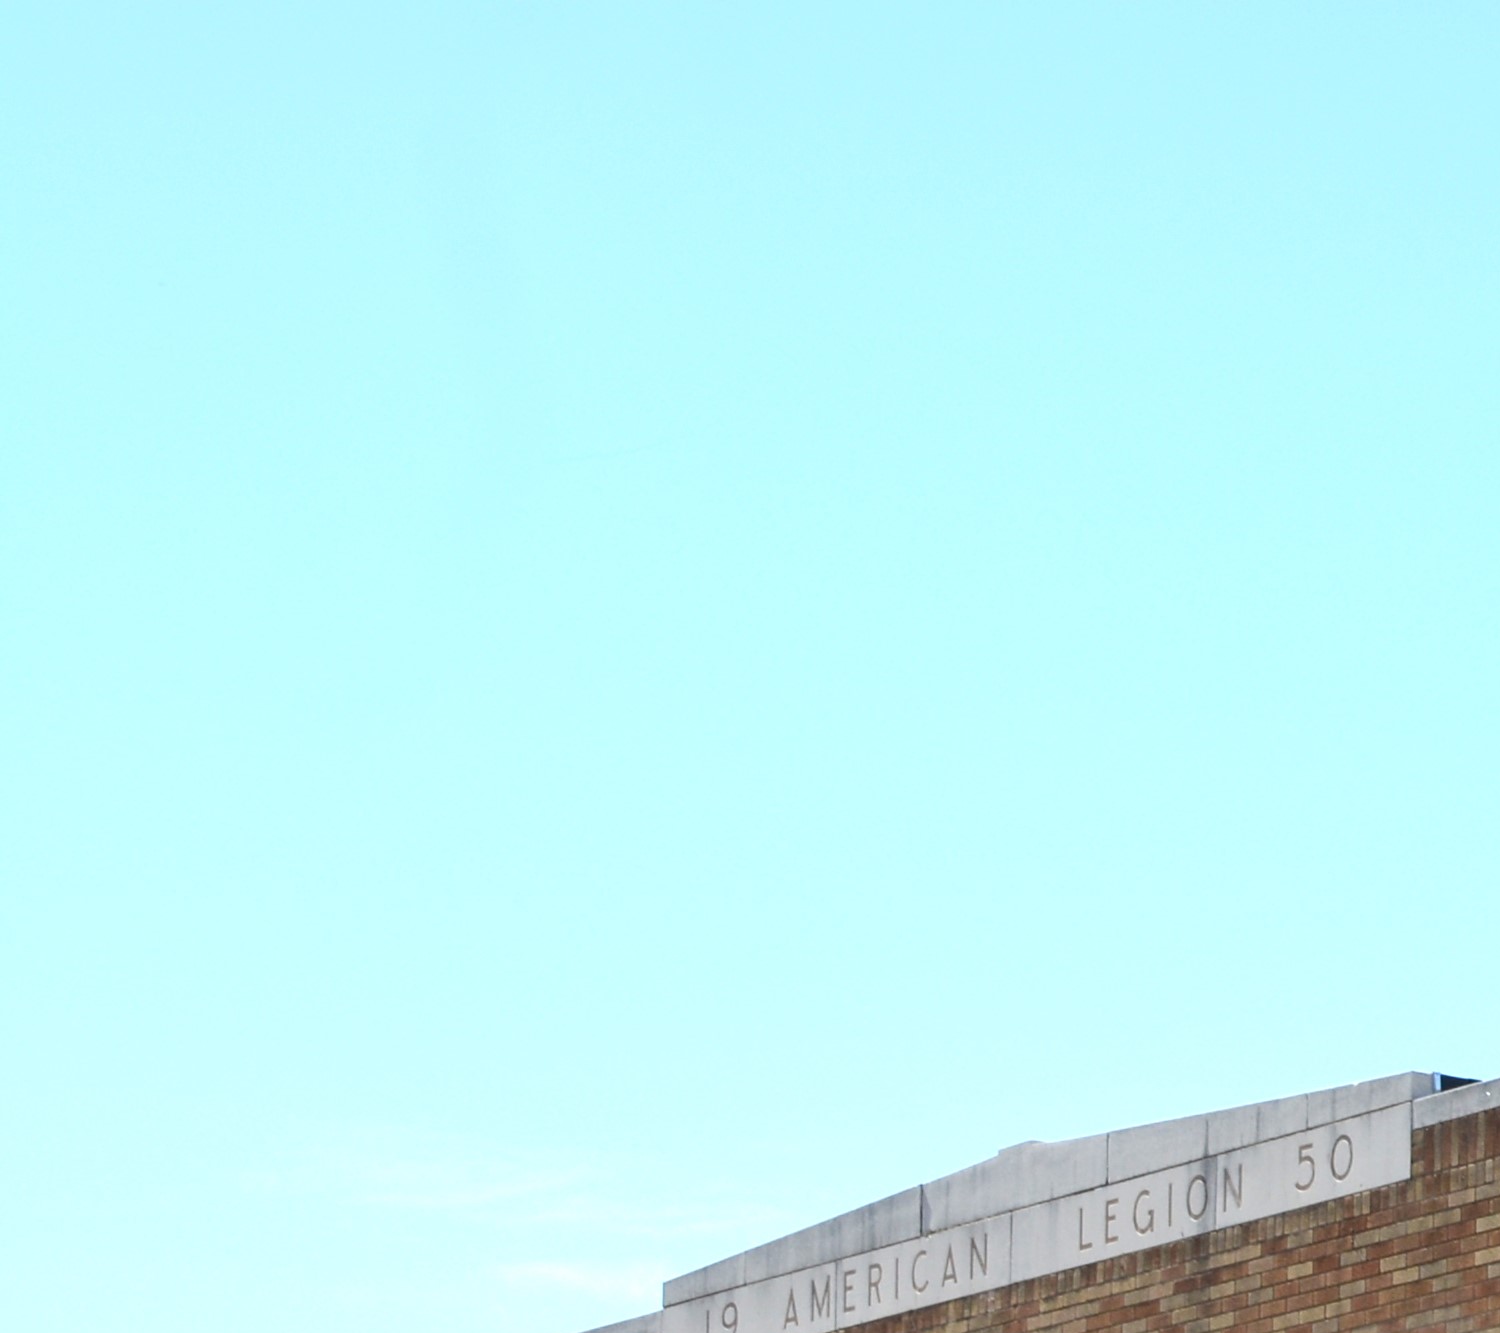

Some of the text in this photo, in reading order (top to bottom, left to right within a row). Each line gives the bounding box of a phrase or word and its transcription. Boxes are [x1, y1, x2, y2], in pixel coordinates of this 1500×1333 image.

[783, 1232, 988, 1331] AMERICAN
[1079, 1163, 1243, 1250] LEGION
[1294, 1134, 1354, 1192] 50
